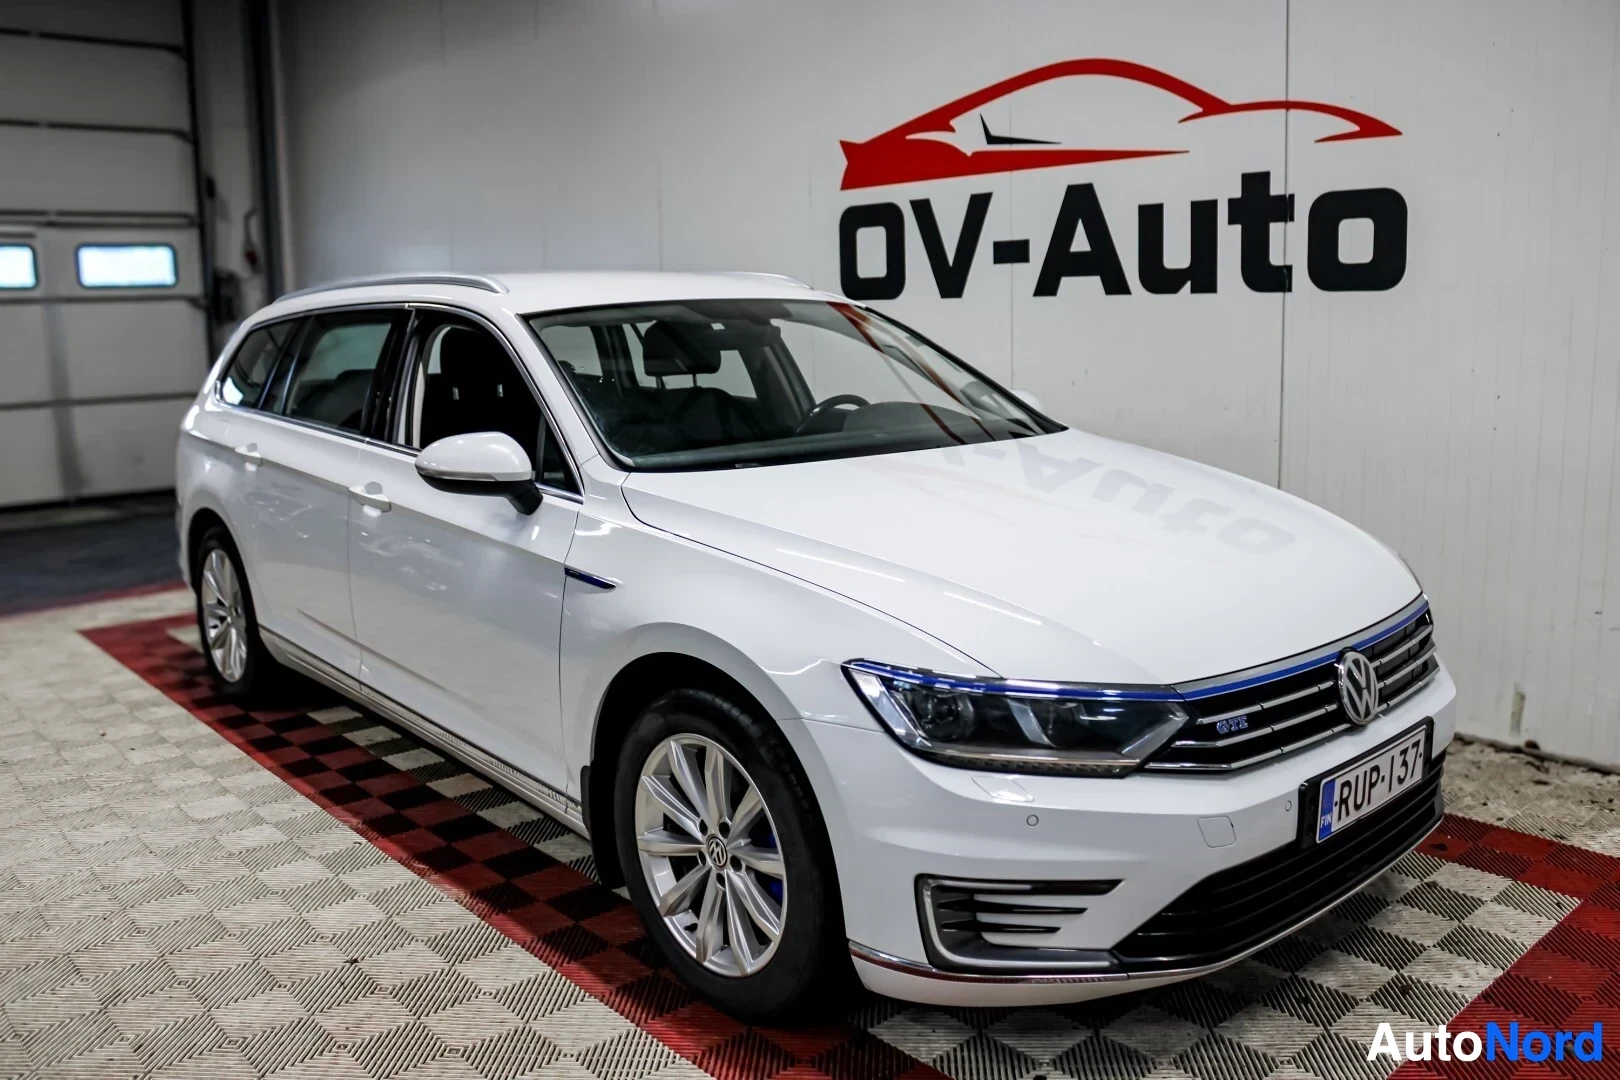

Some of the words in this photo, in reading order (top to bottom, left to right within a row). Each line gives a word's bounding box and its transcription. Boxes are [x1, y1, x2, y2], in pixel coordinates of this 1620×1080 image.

[1216, 715, 1249, 735] GTE
[1337, 738, 1422, 822] RUP-137
[1320, 812, 1333, 829] FIN
